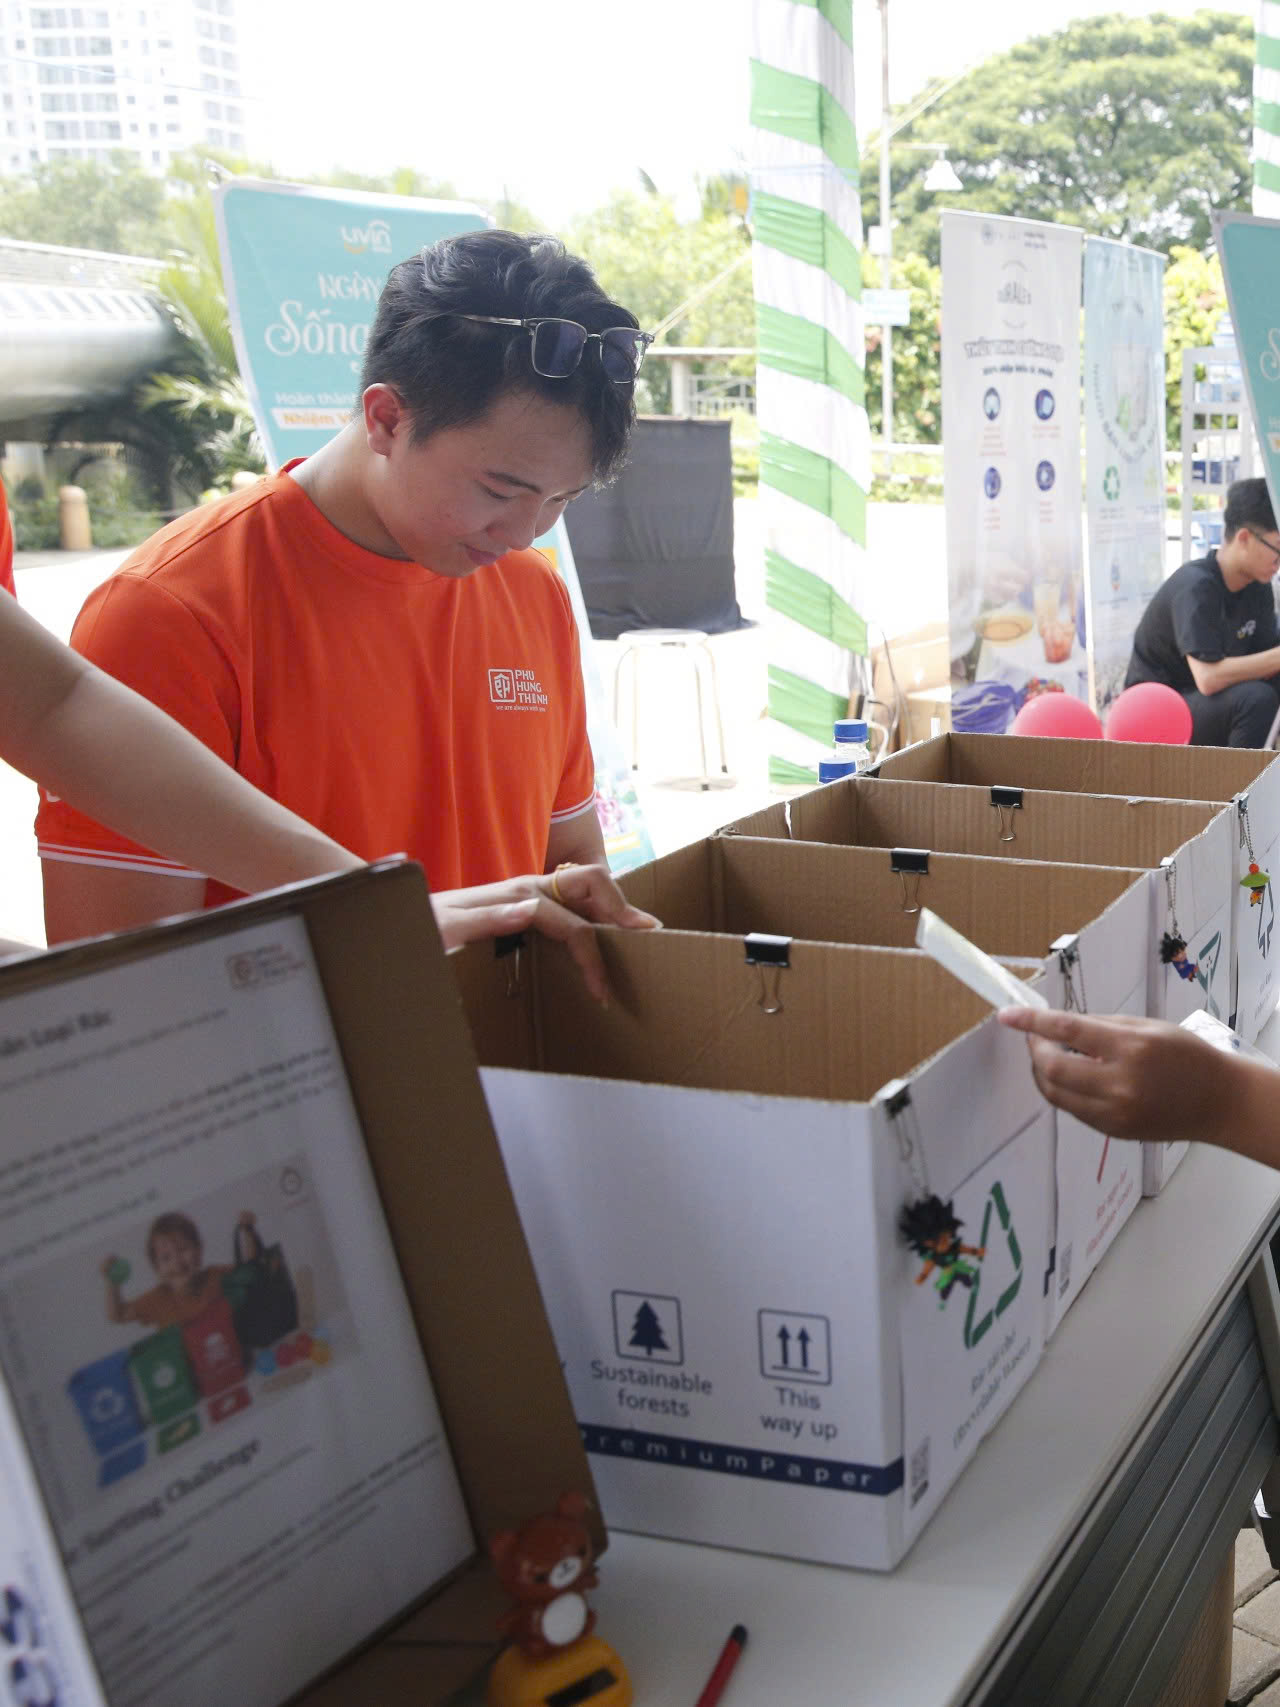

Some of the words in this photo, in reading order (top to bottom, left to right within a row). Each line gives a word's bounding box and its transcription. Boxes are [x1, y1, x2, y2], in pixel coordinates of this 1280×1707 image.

[590, 1360, 713, 1396] Sustainable
[617, 1388, 690, 1418] forests
[775, 1386, 821, 1410] This
[761, 1415, 803, 1439] way
[811, 1421, 838, 1441] up
